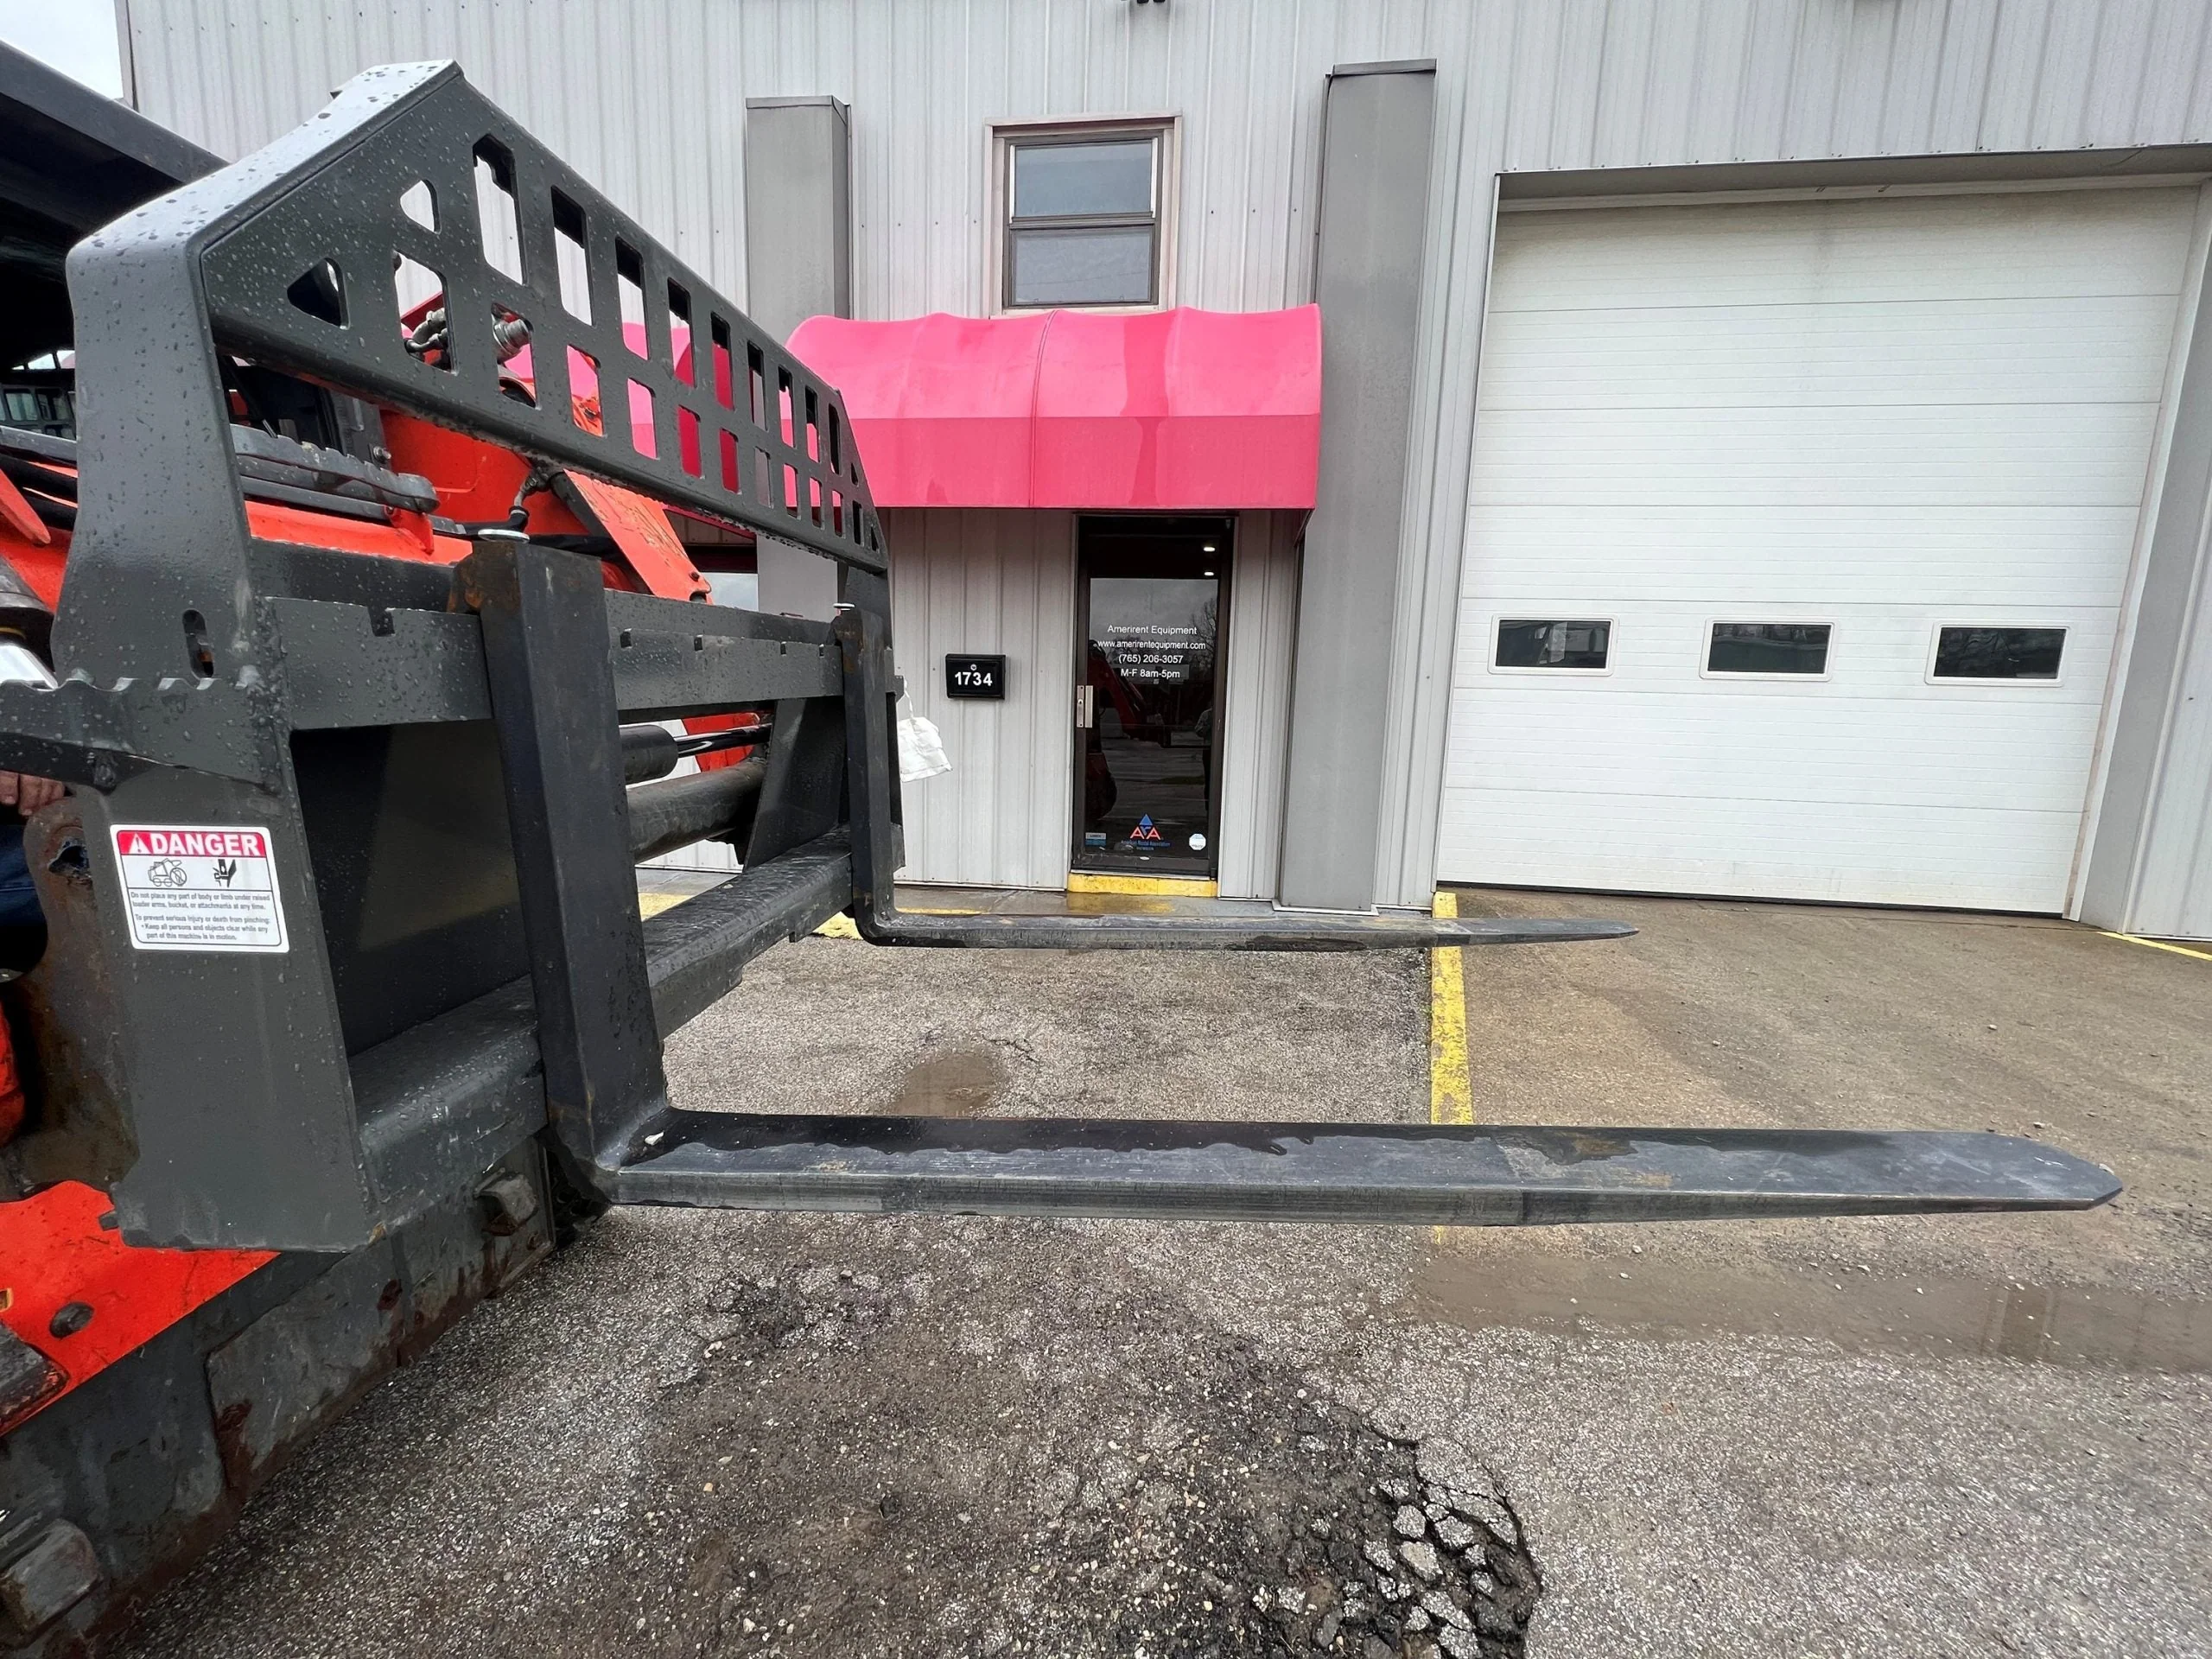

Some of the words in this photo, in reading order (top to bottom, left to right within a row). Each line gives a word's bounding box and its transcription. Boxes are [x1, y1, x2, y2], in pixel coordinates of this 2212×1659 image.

[1107, 625, 1148, 633] Amerirent
[1151, 626, 1198, 635] Equipment
[1097, 640, 1206, 650] www.amerirentequipment.com
[1118, 653, 1141, 664] (765)
[1143, 654, 1184, 664] 206-3057
[955, 671, 993, 686] 1734
[1140, 670, 1180, 680] 8am-5pm
[149, 832, 261, 856] DANGER
[198, 893, 212, 901] body
